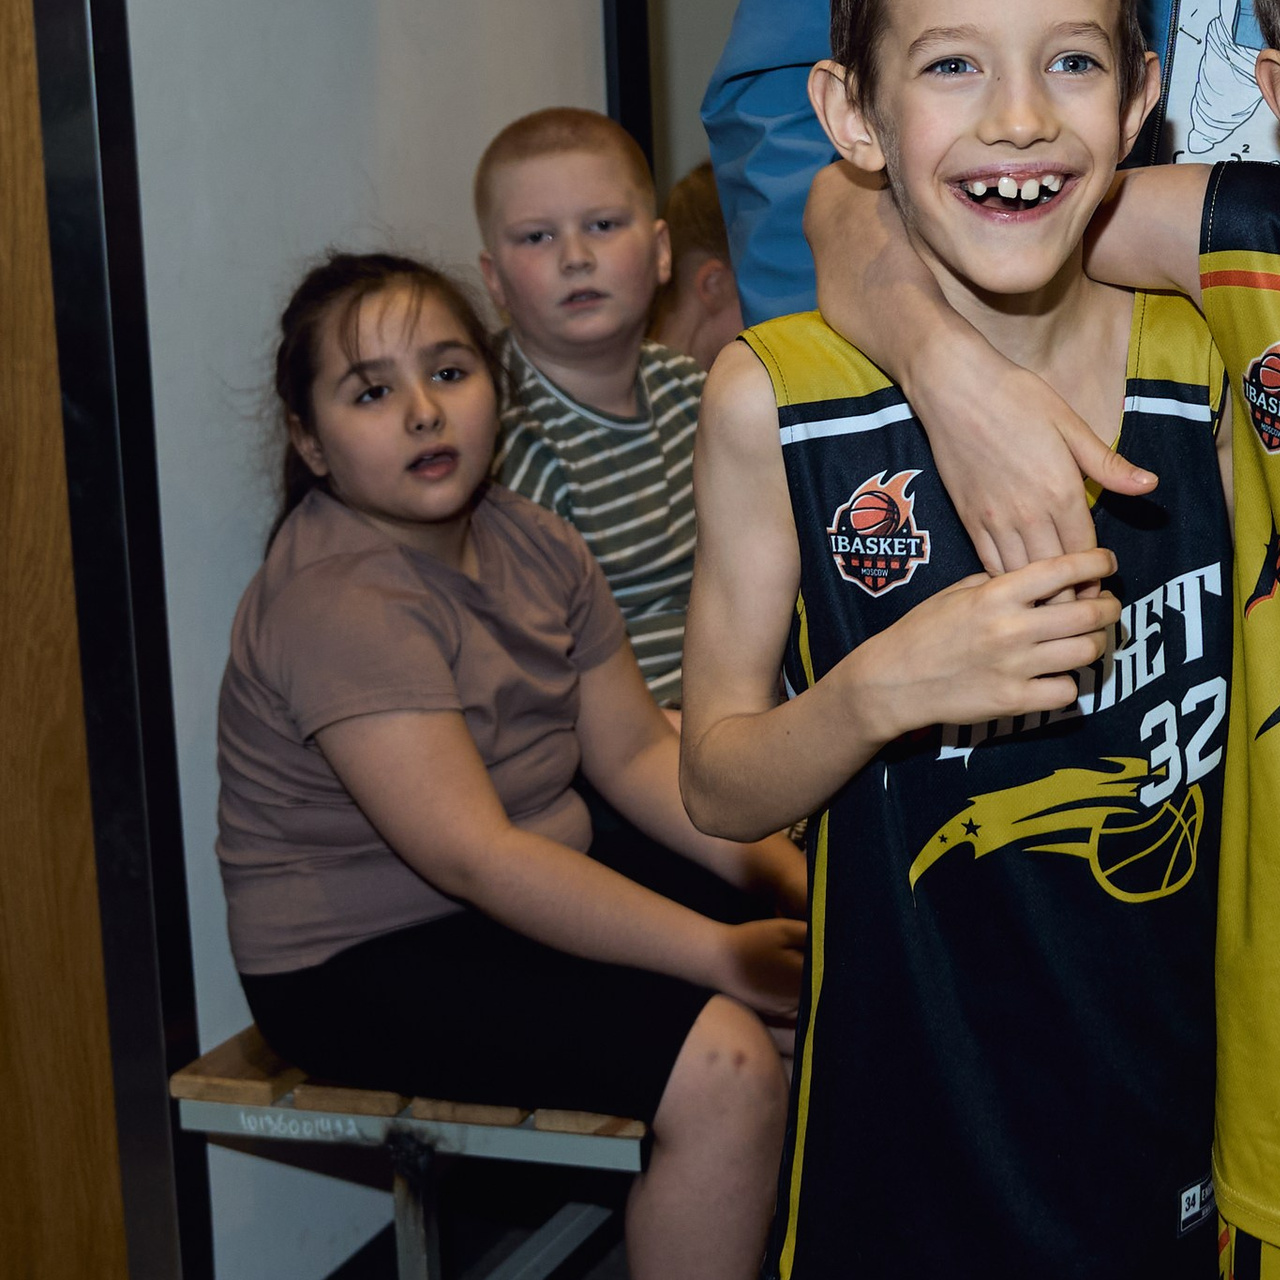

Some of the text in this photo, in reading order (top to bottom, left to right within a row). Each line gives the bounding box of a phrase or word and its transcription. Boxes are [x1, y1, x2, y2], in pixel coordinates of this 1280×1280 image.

[830, 535, 920, 556] IBASKET
[861, 568, 889, 578] MOSCOW
[1139, 676, 1227, 808] 32
[1185, 1193, 1197, 1212] 34
